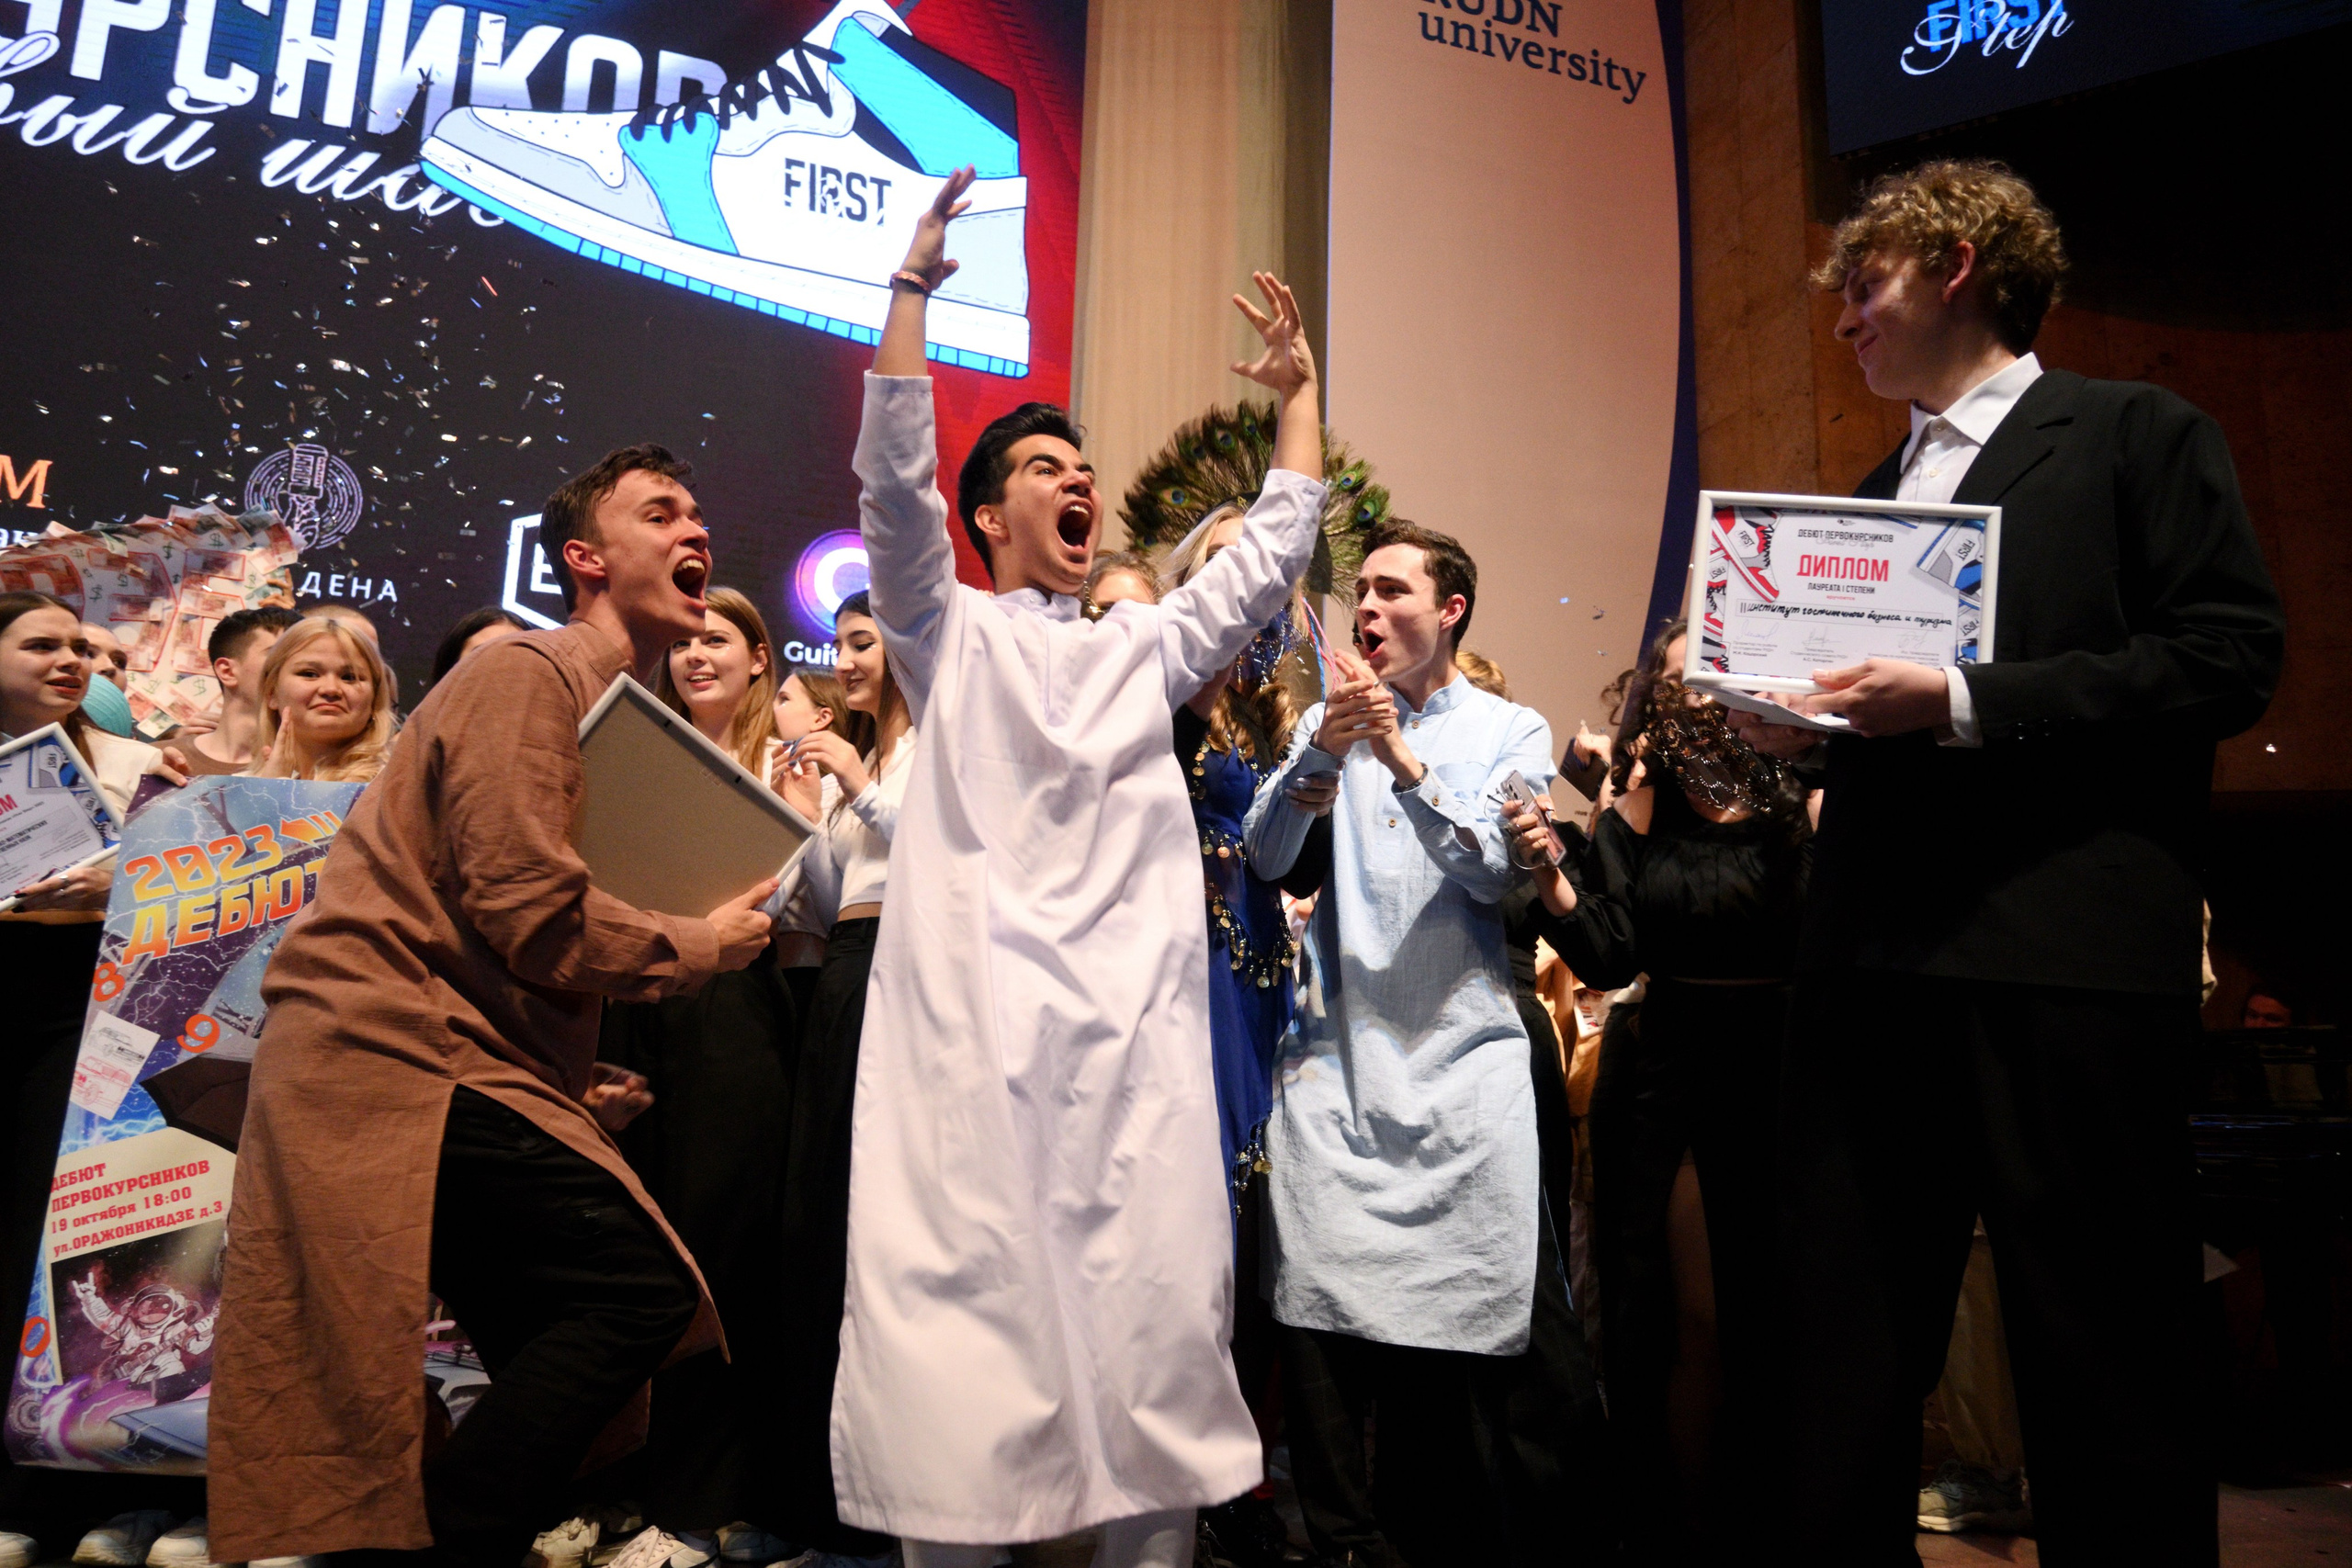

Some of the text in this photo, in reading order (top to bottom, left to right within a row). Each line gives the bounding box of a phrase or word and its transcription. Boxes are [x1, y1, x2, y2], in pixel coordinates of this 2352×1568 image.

[1419, 12, 1646, 105] university
[261, 138, 505, 228] ша
[785, 157, 892, 227] FIRST
[1738, 530, 1755, 547] FIRST
[1797, 528, 1894, 543] ДЕБЮТ ПЕРВОКУРСНИКОВ
[1955, 538, 1975, 561] FIRST
[1796, 554, 1890, 582] ДИПЛОМ
[1807, 582, 1841, 592] ЛАУРЕАТА
[1846, 586, 1876, 594] СТЕПЕНИ
[125, 824, 284, 902] 2023
[93, 962, 126, 1002] 8
[176, 1014, 220, 1054] 9
[51, 1163, 107, 1193] ДЕБЮТ
[51, 1160, 210, 1213] ПЕРВОКУРСНИКОВ
[51, 1187, 192, 1234] 19 октября 18:00
[199, 1201, 222, 1219] д.3
